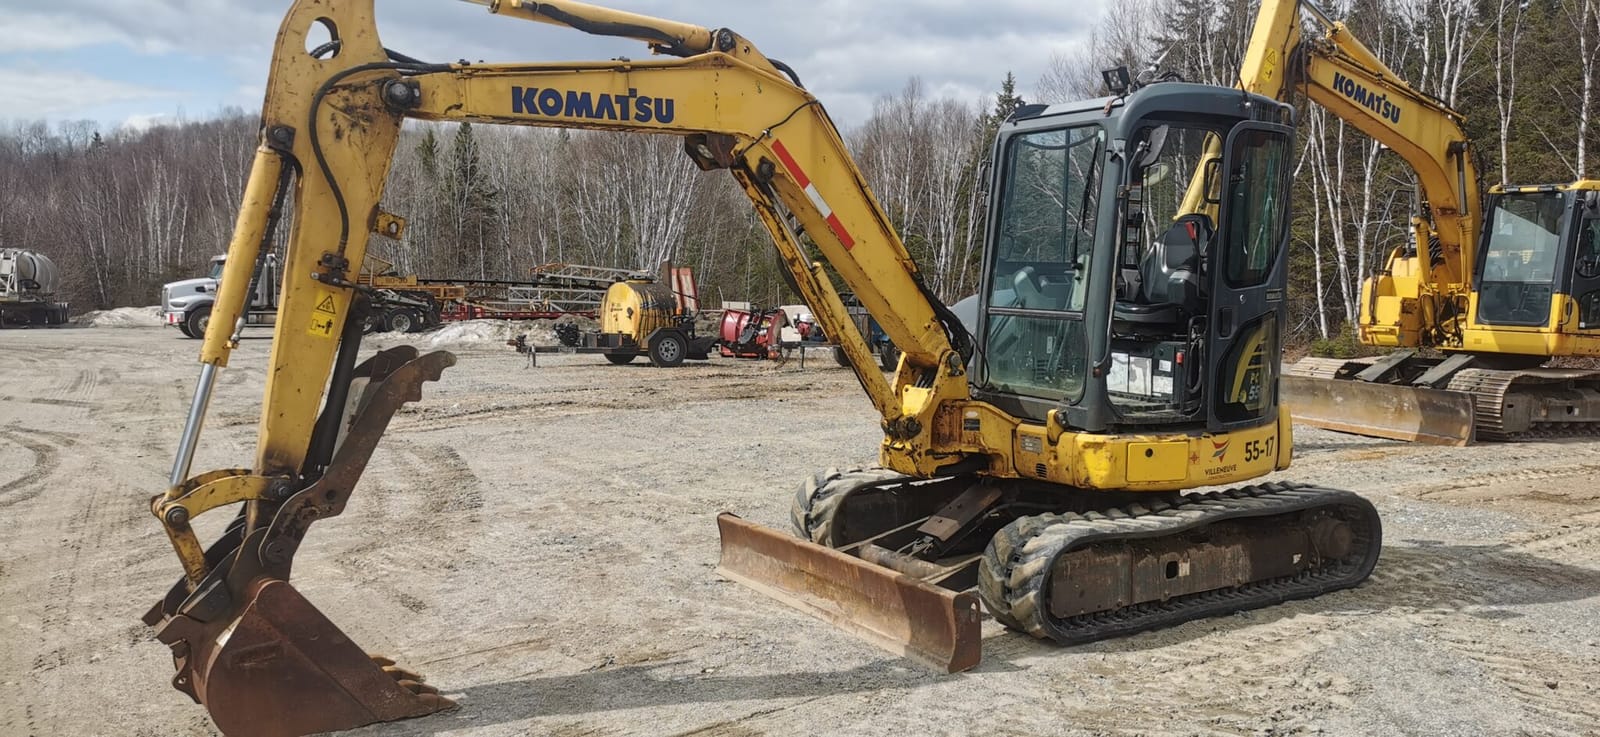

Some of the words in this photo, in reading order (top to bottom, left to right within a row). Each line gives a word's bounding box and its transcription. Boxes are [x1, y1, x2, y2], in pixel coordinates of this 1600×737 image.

[511, 86, 674, 124] KOMATSU
[1332, 71, 1401, 124] KOMATSU
[1244, 435, 1275, 462] 55-17
[1204, 464, 1237, 476] VILLENEUVE
